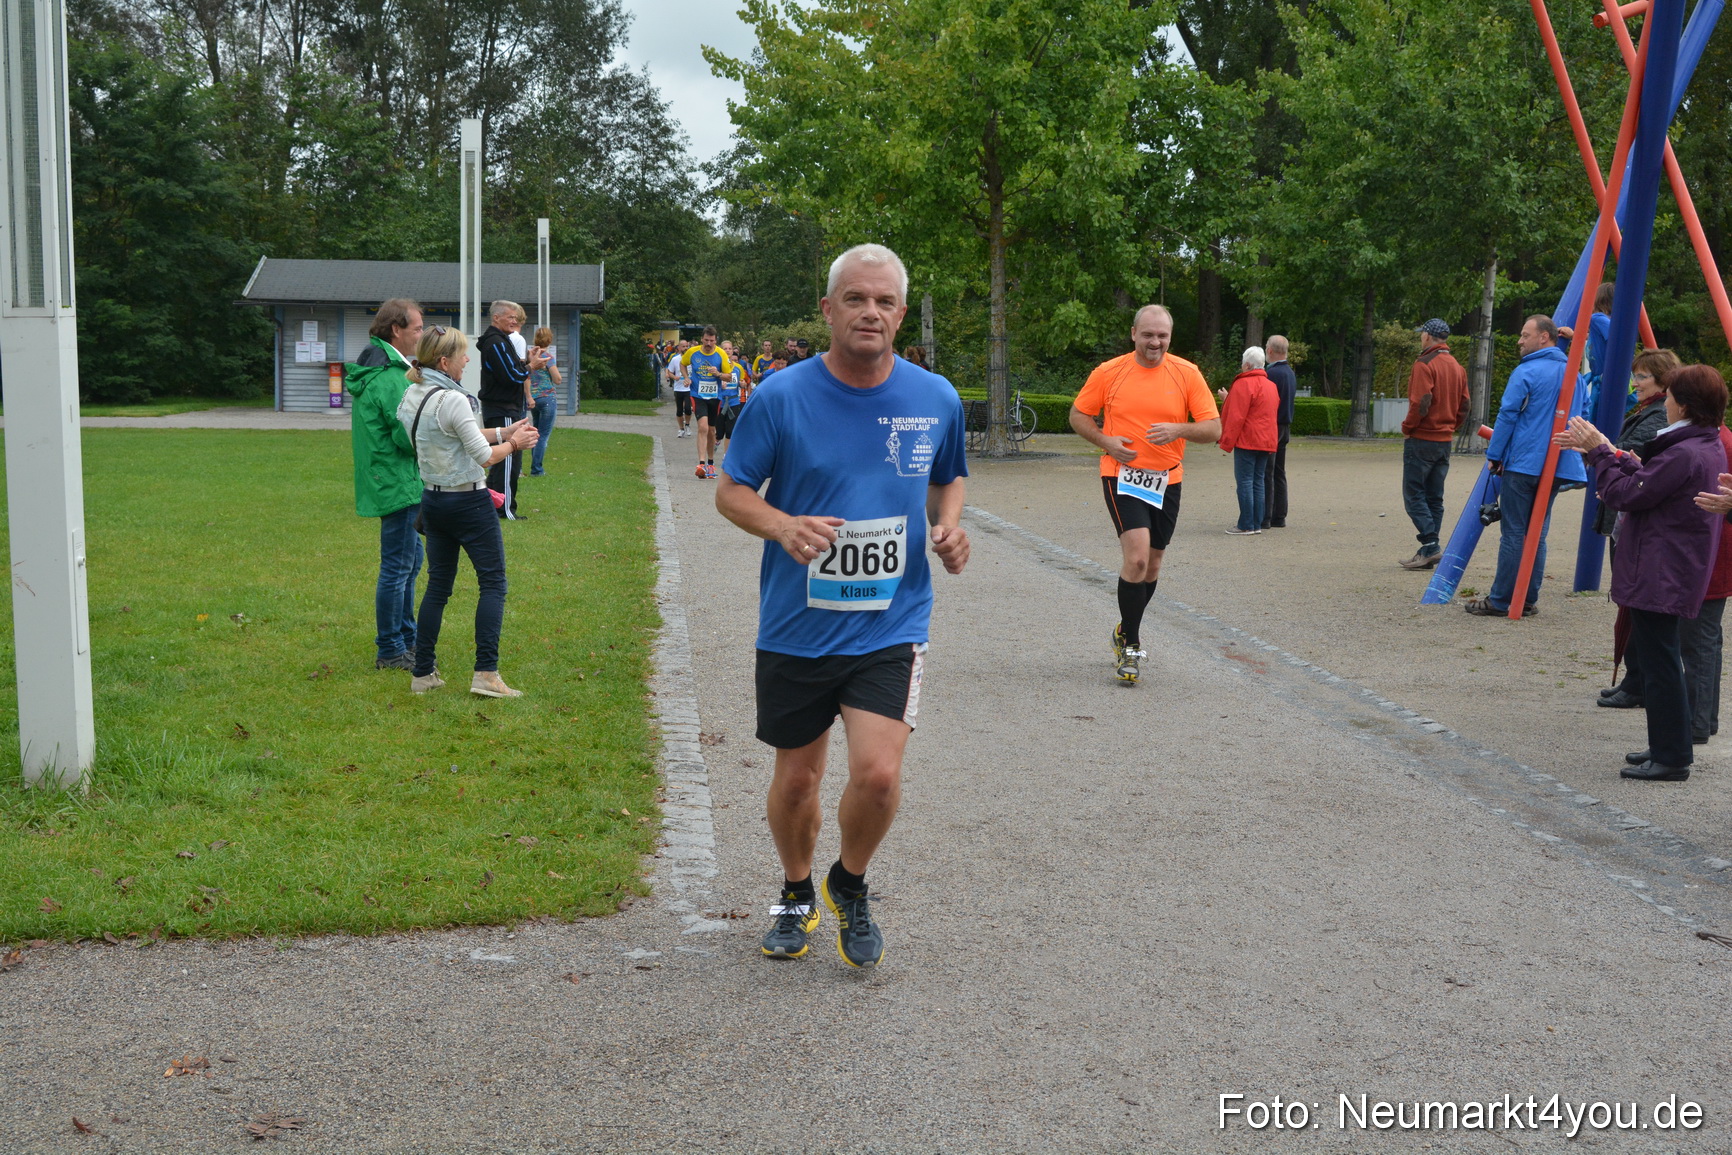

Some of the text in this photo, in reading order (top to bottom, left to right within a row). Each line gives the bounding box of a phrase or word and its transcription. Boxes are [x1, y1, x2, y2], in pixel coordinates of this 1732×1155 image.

[700, 385, 717, 393] 2784
[877, 417, 939, 425] 12. NEUMARKTER
[1123, 468, 1163, 492] 3381
[846, 528, 892, 539] Neumarkt
[819, 539, 899, 577] 2068
[840, 584, 877, 598] Klaus
